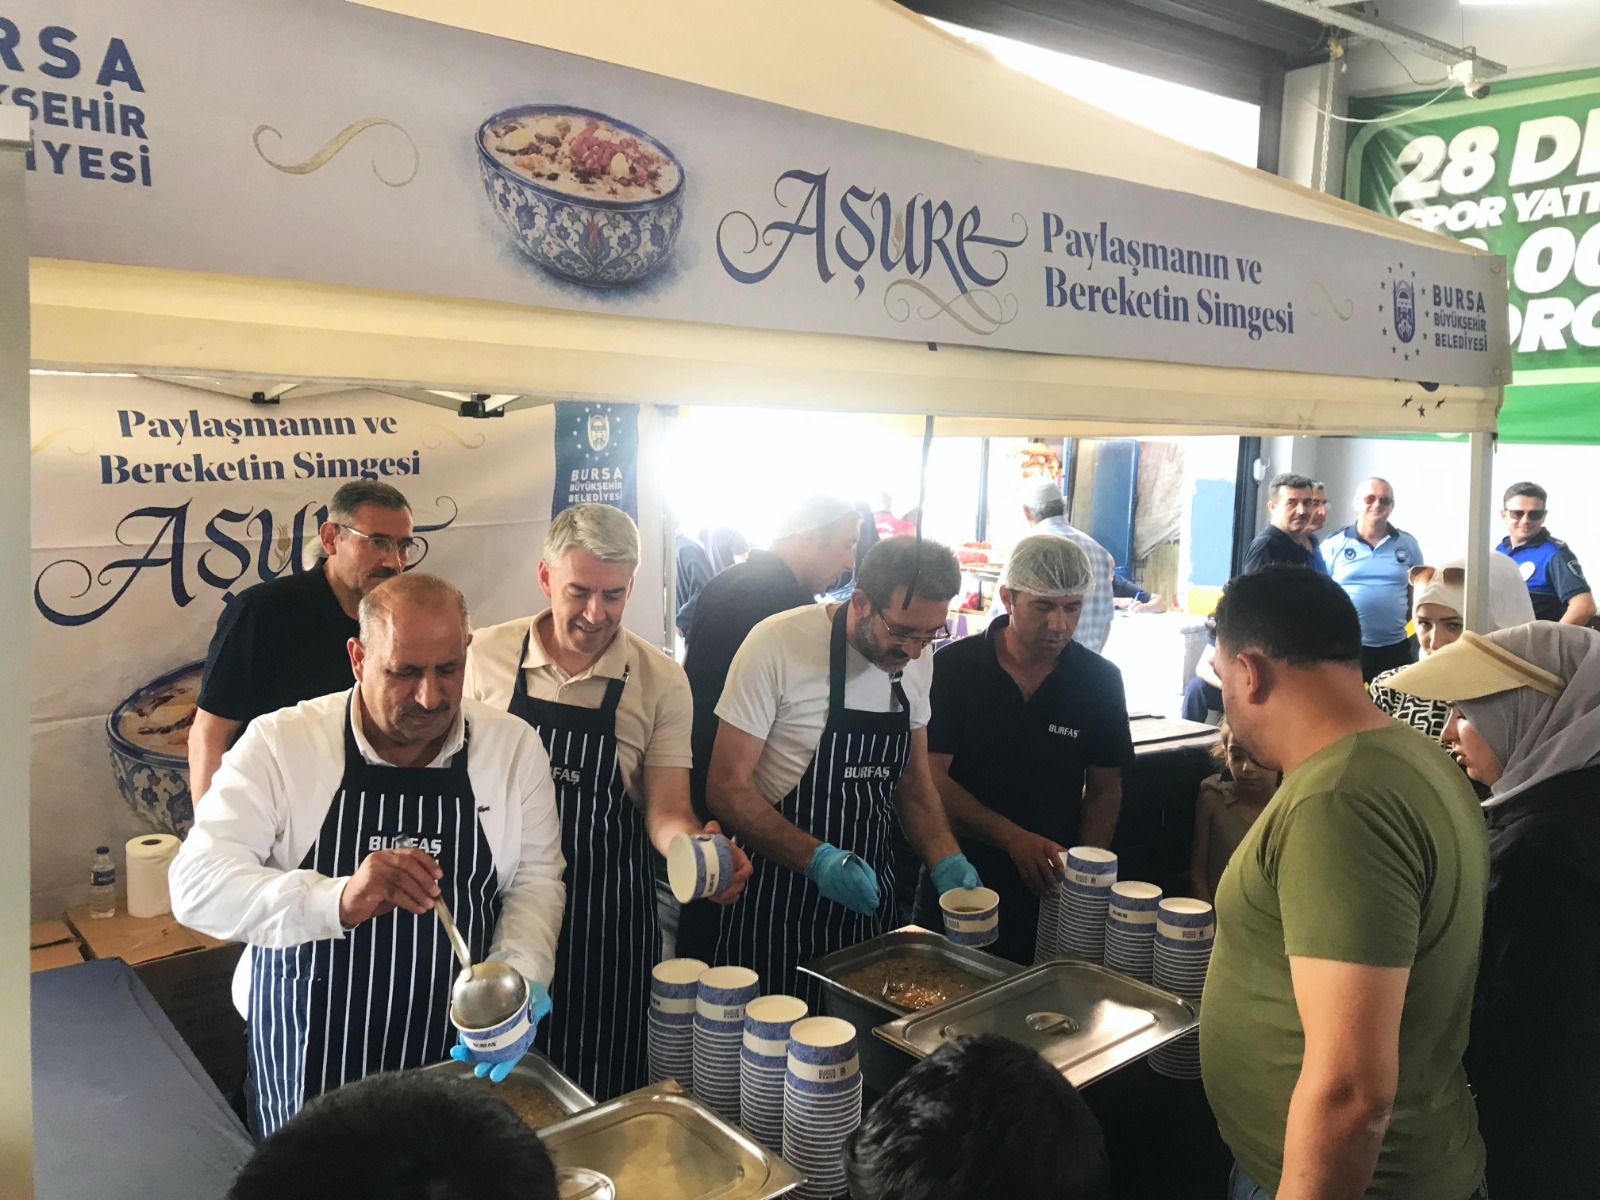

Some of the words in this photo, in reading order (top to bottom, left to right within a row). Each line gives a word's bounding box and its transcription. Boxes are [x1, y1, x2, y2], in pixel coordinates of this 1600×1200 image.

[1389, 126, 1500, 202] 28
[1041, 211, 1230, 276] Paylaşmanın
[1236, 257, 1262, 284] ve
[1044, 266, 1189, 322] Bereketin
[1197, 287, 1294, 341] Simgesi
[1432, 284, 1486, 313] BURSA
[1435, 332, 1487, 352] BELEDİYESİ
[117, 409, 356, 445] Paylaşmanın
[362, 416, 398, 435] ve
[100, 453, 285, 484] Bereketin
[293, 449, 420, 481] Simgesi
[571, 467, 623, 481] BURSA
[568, 492, 623, 503] BELEDİYESİ
[844, 766, 890, 781] BURFAŞ
